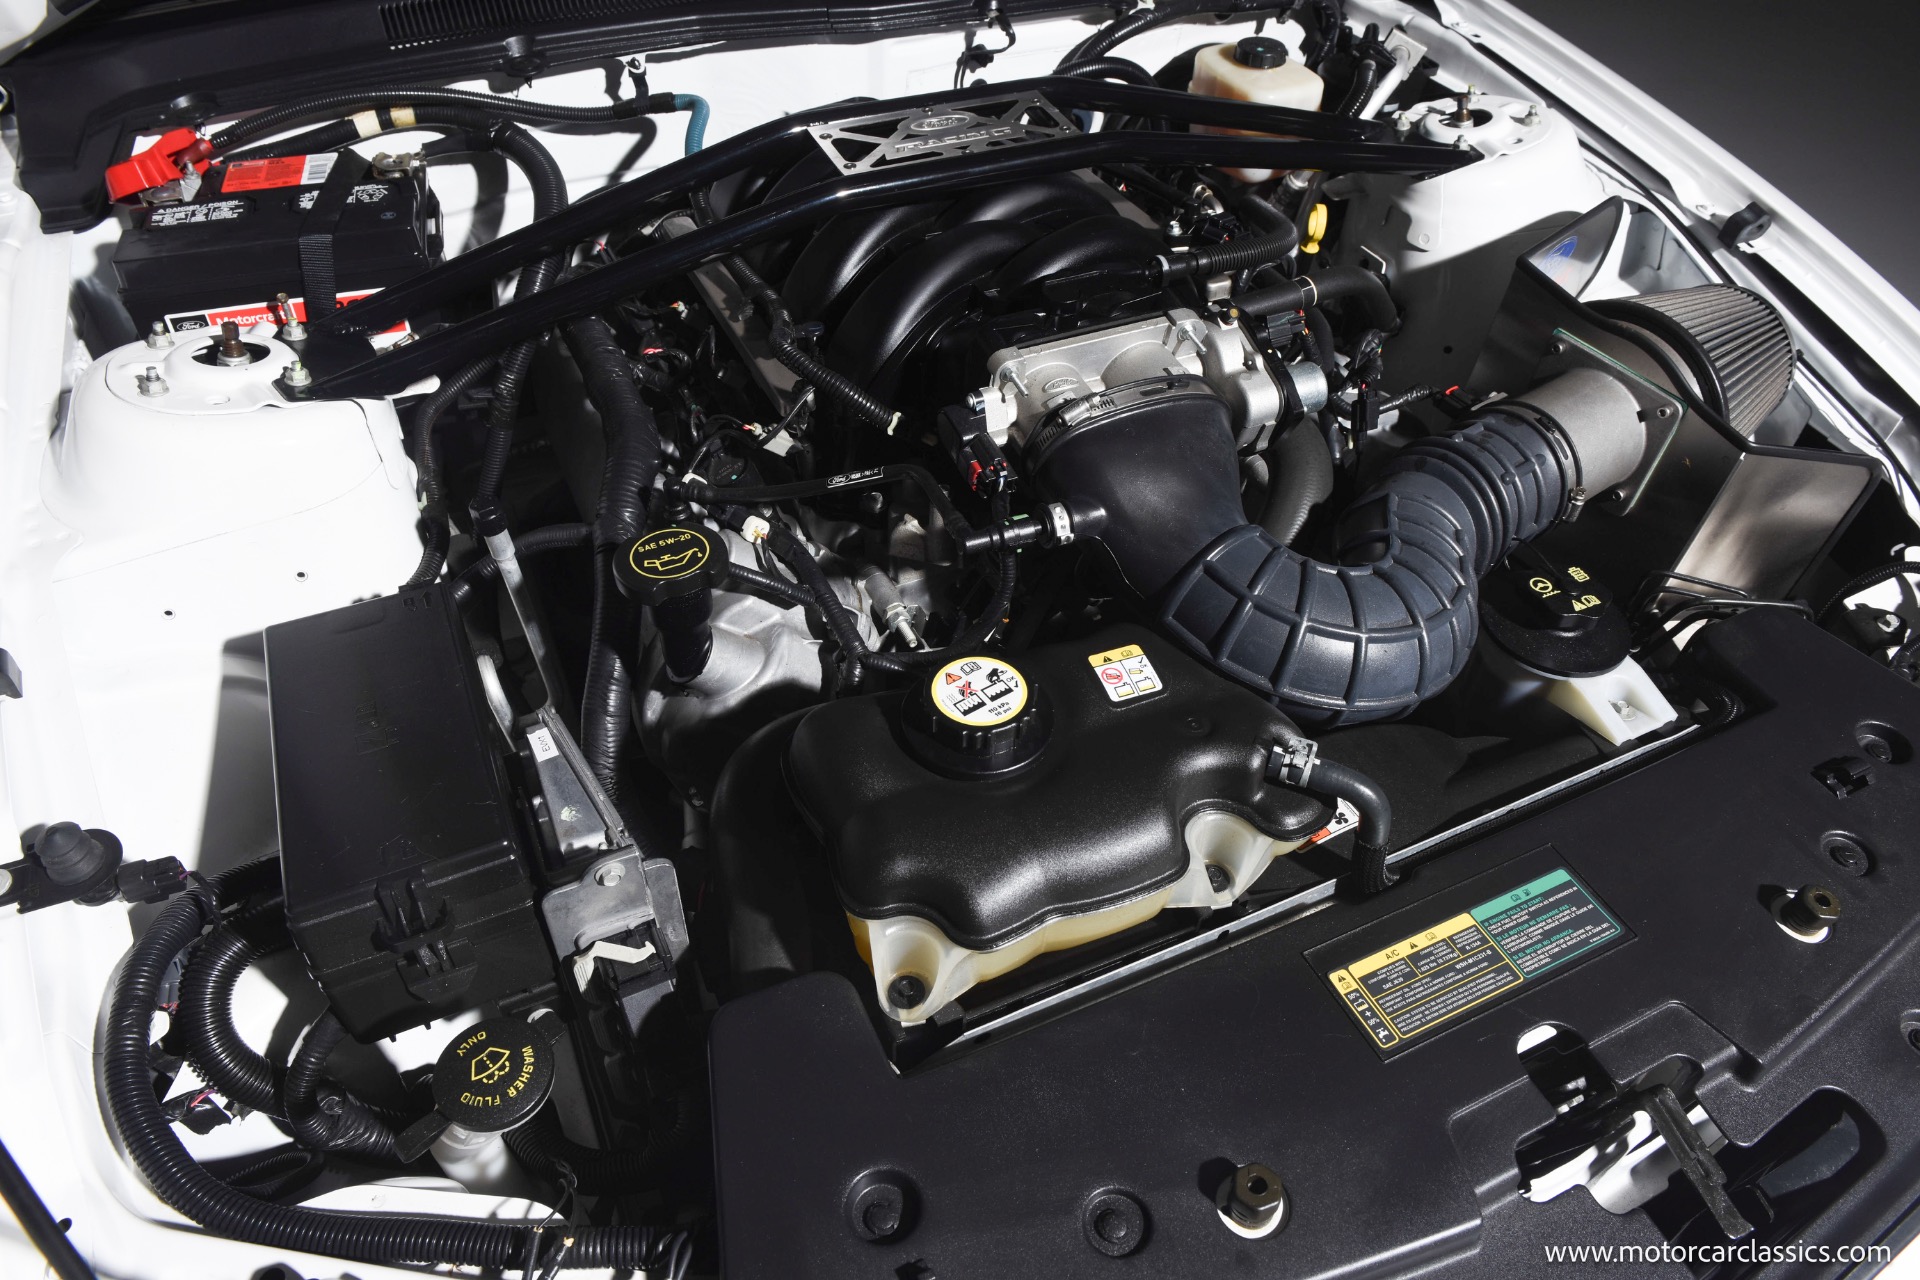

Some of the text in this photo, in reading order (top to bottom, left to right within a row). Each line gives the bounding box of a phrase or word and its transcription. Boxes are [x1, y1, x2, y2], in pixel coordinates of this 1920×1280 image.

[895, 127, 1012, 153] RACING
[166, 200, 238, 213] DANGER POISON
[638, 533, 692, 554] SAE 5W-20
[1486, 921, 1502, 931] CHECK
[1500, 917, 1513, 925] FUEL
[1510, 909, 1530, 920] SHUTOFF
[1527, 902, 1545, 912] SWITCH
[1547, 888, 1575, 903] REFERENCED
[1488, 913, 1508, 925] ENGINE
[1506, 906, 1522, 916] FAILS
[1550, 909, 1572, 921] COUPURE
[1507, 922, 1530, 936] MOTEUR
[1558, 904, 1571, 912] PAS
[1490, 926, 1504, 935] YOUR
[1501, 920, 1519, 930] OWNER
[1464, 940, 1482, 951] R-134A
[1524, 942, 1544, 954] MOTOR
[1383, 948, 1402, 961] A/C
[1381, 981, 1394, 990] SAE
[1346, 990, 1361, 1001] 50%
[1366, 1016, 1381, 1027] 50%
[457, 1032, 534, 1106] WASHER FLUID ONLY
